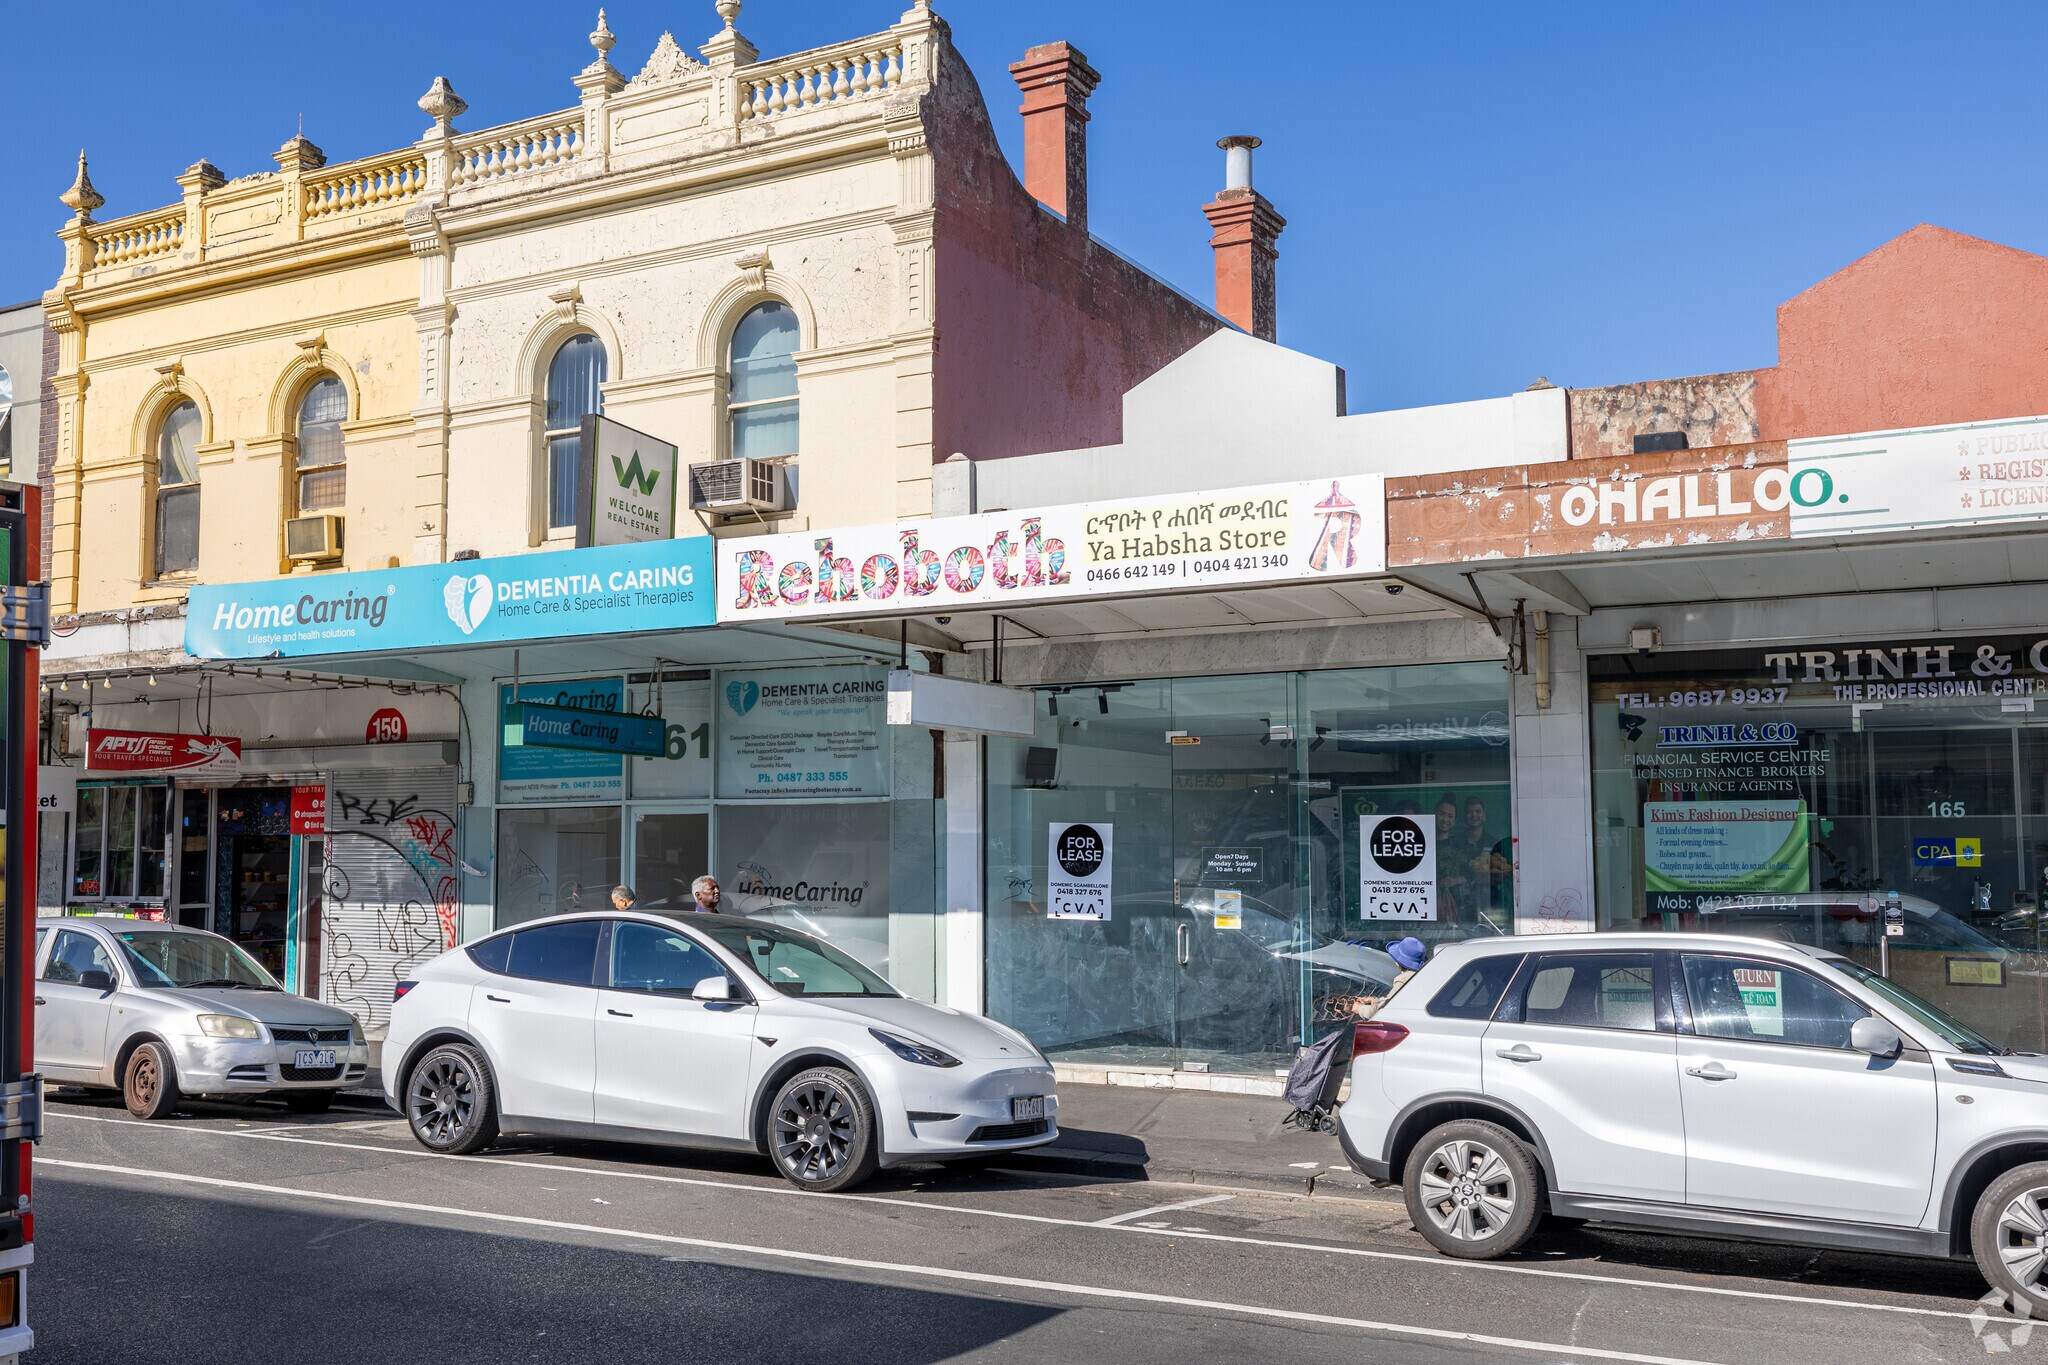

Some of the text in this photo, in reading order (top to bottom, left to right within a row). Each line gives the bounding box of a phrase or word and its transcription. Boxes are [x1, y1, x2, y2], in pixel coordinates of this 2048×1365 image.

[1980, 485, 2048, 508] LICEN
[609, 497, 659, 522] WELCOME
[1219, 499, 1288, 521] መደብር
[607, 512, 659, 535] REAL ESTATE
[1088, 529, 1286, 561] Ya Habsha Store
[735, 516, 1071, 610] Rehoboth
[1087, 554, 1289, 582] 0466 642 149 0404 421 340
[497, 565, 693, 601] DEMENTIA CARING
[498, 589, 694, 617] Home Care & Specialist Therapies
[247, 628, 355, 645] Lifestyle and health solutions
[1765, 645, 2013, 684] TRINH &
[762, 681, 884, 698] DEMENTIA CARING
[1833, 677, 2048, 701] THE PROFESSIONAL CENTR
[762, 694, 884, 707] Home Care & Specialist Therapies
[1615, 687, 1789, 709] TEL: 9687 9937
[793, 708, 812, 717] speak
[815, 708, 831, 716] your
[372, 716, 401, 741] 159
[528, 715, 619, 744] HomeCaring
[1659, 723, 1797, 743] TRINH & CO
[644, 723, 709, 760] 61
[1623, 750, 1830, 766] FINANCIAL SERVICE CENTRE
[758, 772, 848, 783] Ph. 0487 333 555
[1630, 766, 1825, 779] LICENSED FINANCE BROKERS
[1659, 780, 1793, 793] INSURANCE AGENTS
[38, 794, 58, 808] et
[1651, 807, 1798, 822] Kim's Fashion Designer
[1927, 801, 1966, 818] 165
[1382, 830, 1415, 843] FOR
[1655, 826, 1664, 835] All
[1665, 826, 1681, 835] kinds
[1681, 826, 1687, 835] of
[1687, 826, 1702, 835] dress
[1067, 837, 1095, 849] FOR
[1373, 844, 1423, 857] LEASE
[1659, 838, 1680, 847] Formal
[1681, 839, 1701, 848] evening
[1060, 849, 1101, 861] LEASE
[1659, 850, 1676, 858] Robes
[1677, 850, 1687, 858] and
[1916, 845, 1953, 859] CPA
[1657, 895, 1691, 909] Mob:
[1734, 969, 1771, 983] ETURN
[1953, 966, 1980, 977] CPA
